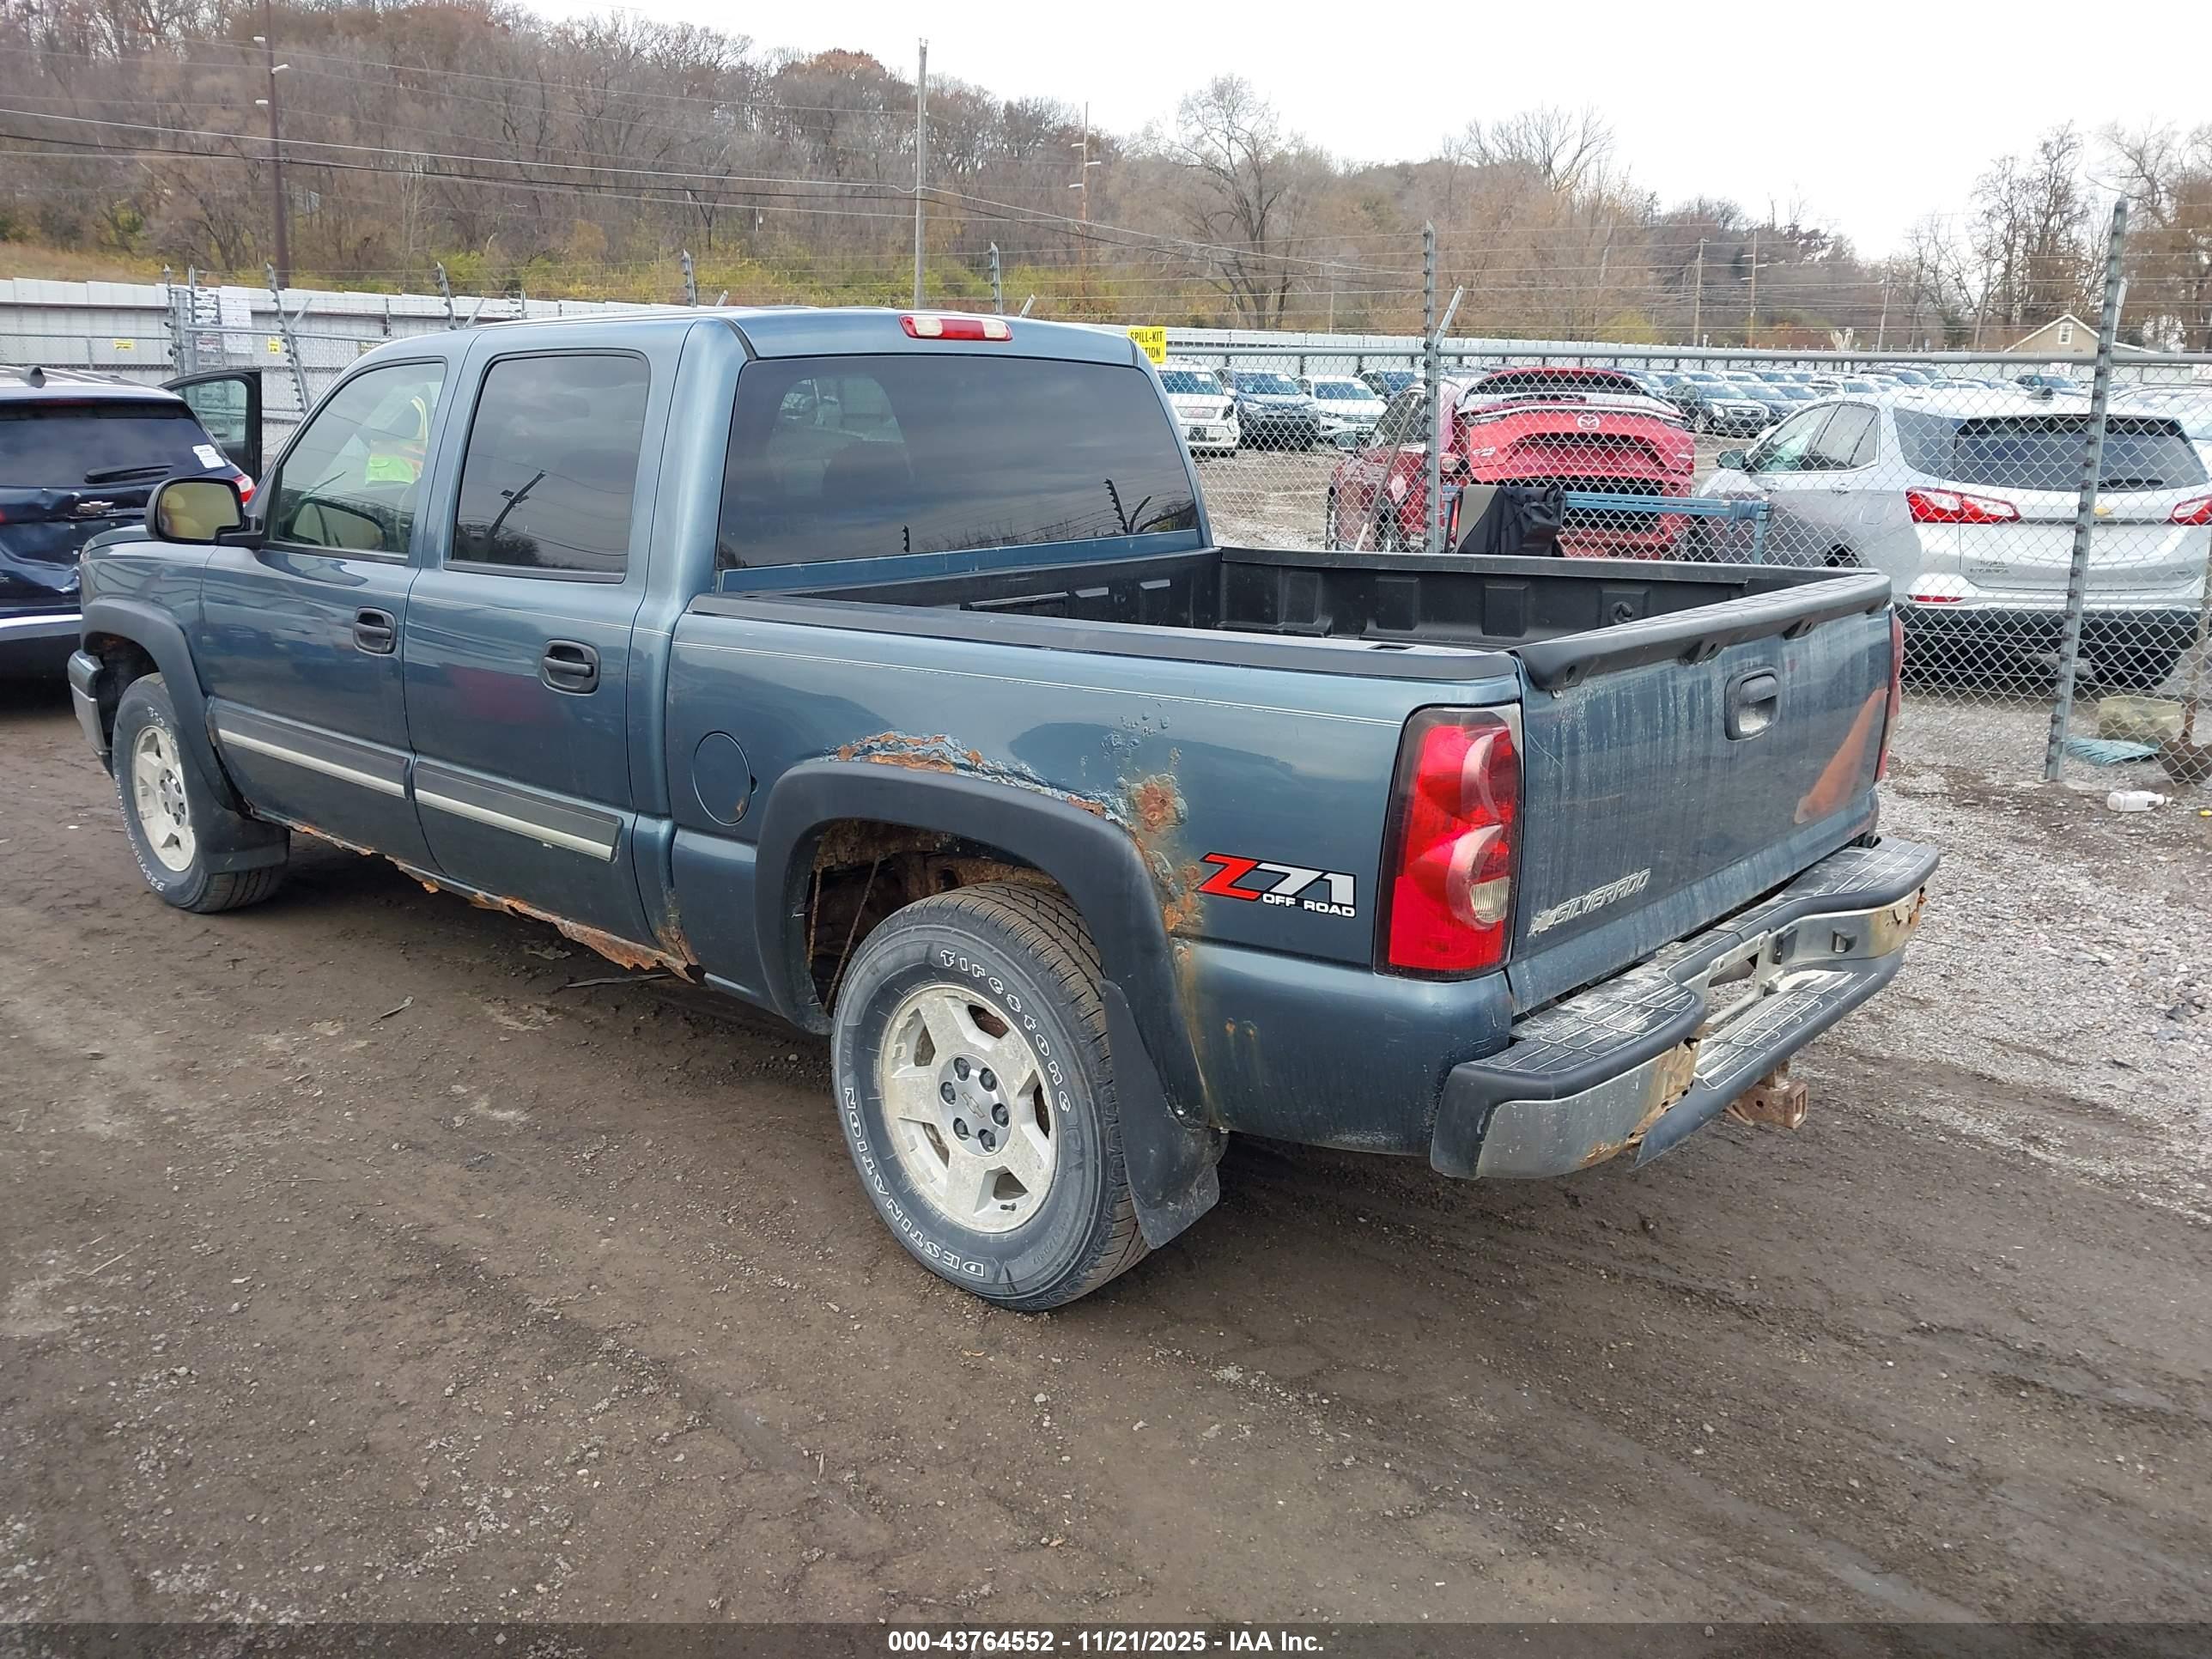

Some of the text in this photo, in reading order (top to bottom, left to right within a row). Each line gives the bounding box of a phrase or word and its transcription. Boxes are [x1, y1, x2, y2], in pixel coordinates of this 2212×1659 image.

[1130, 331, 1164, 343] SPILL-KIT
[1197, 852, 1357, 906] Z71
[1262, 894, 1357, 918] OFF ROAD
[1553, 868, 1651, 925] SILVERADO
[844, 1087, 986, 1278] DESTINATION
